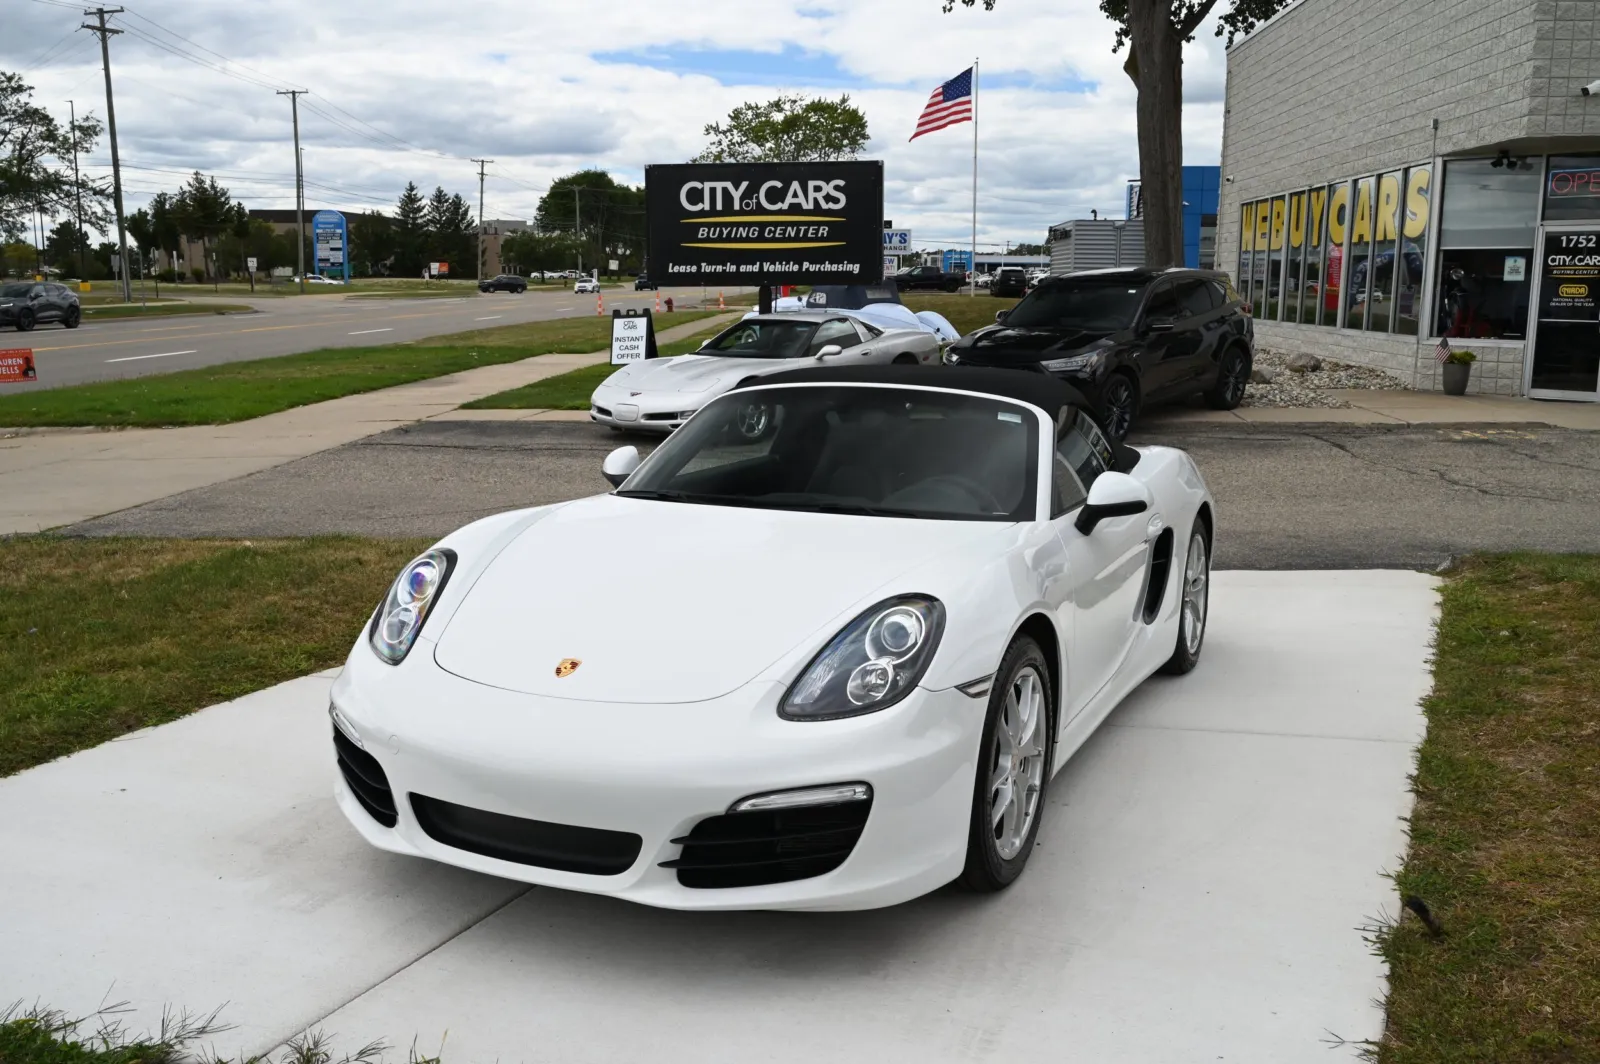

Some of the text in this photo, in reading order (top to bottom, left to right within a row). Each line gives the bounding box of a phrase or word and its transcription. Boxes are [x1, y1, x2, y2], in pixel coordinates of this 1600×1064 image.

[680, 179, 847, 211] CITY of CARS
[1242, 169, 1431, 250] WE BUY CARS
[697, 225, 829, 238] BUYING CENTER
[1561, 235, 1597, 247] 1752
[1548, 255, 1572, 266] CITY
[668, 261, 860, 274] Lease Turn-In and Vehicle Purchasing
